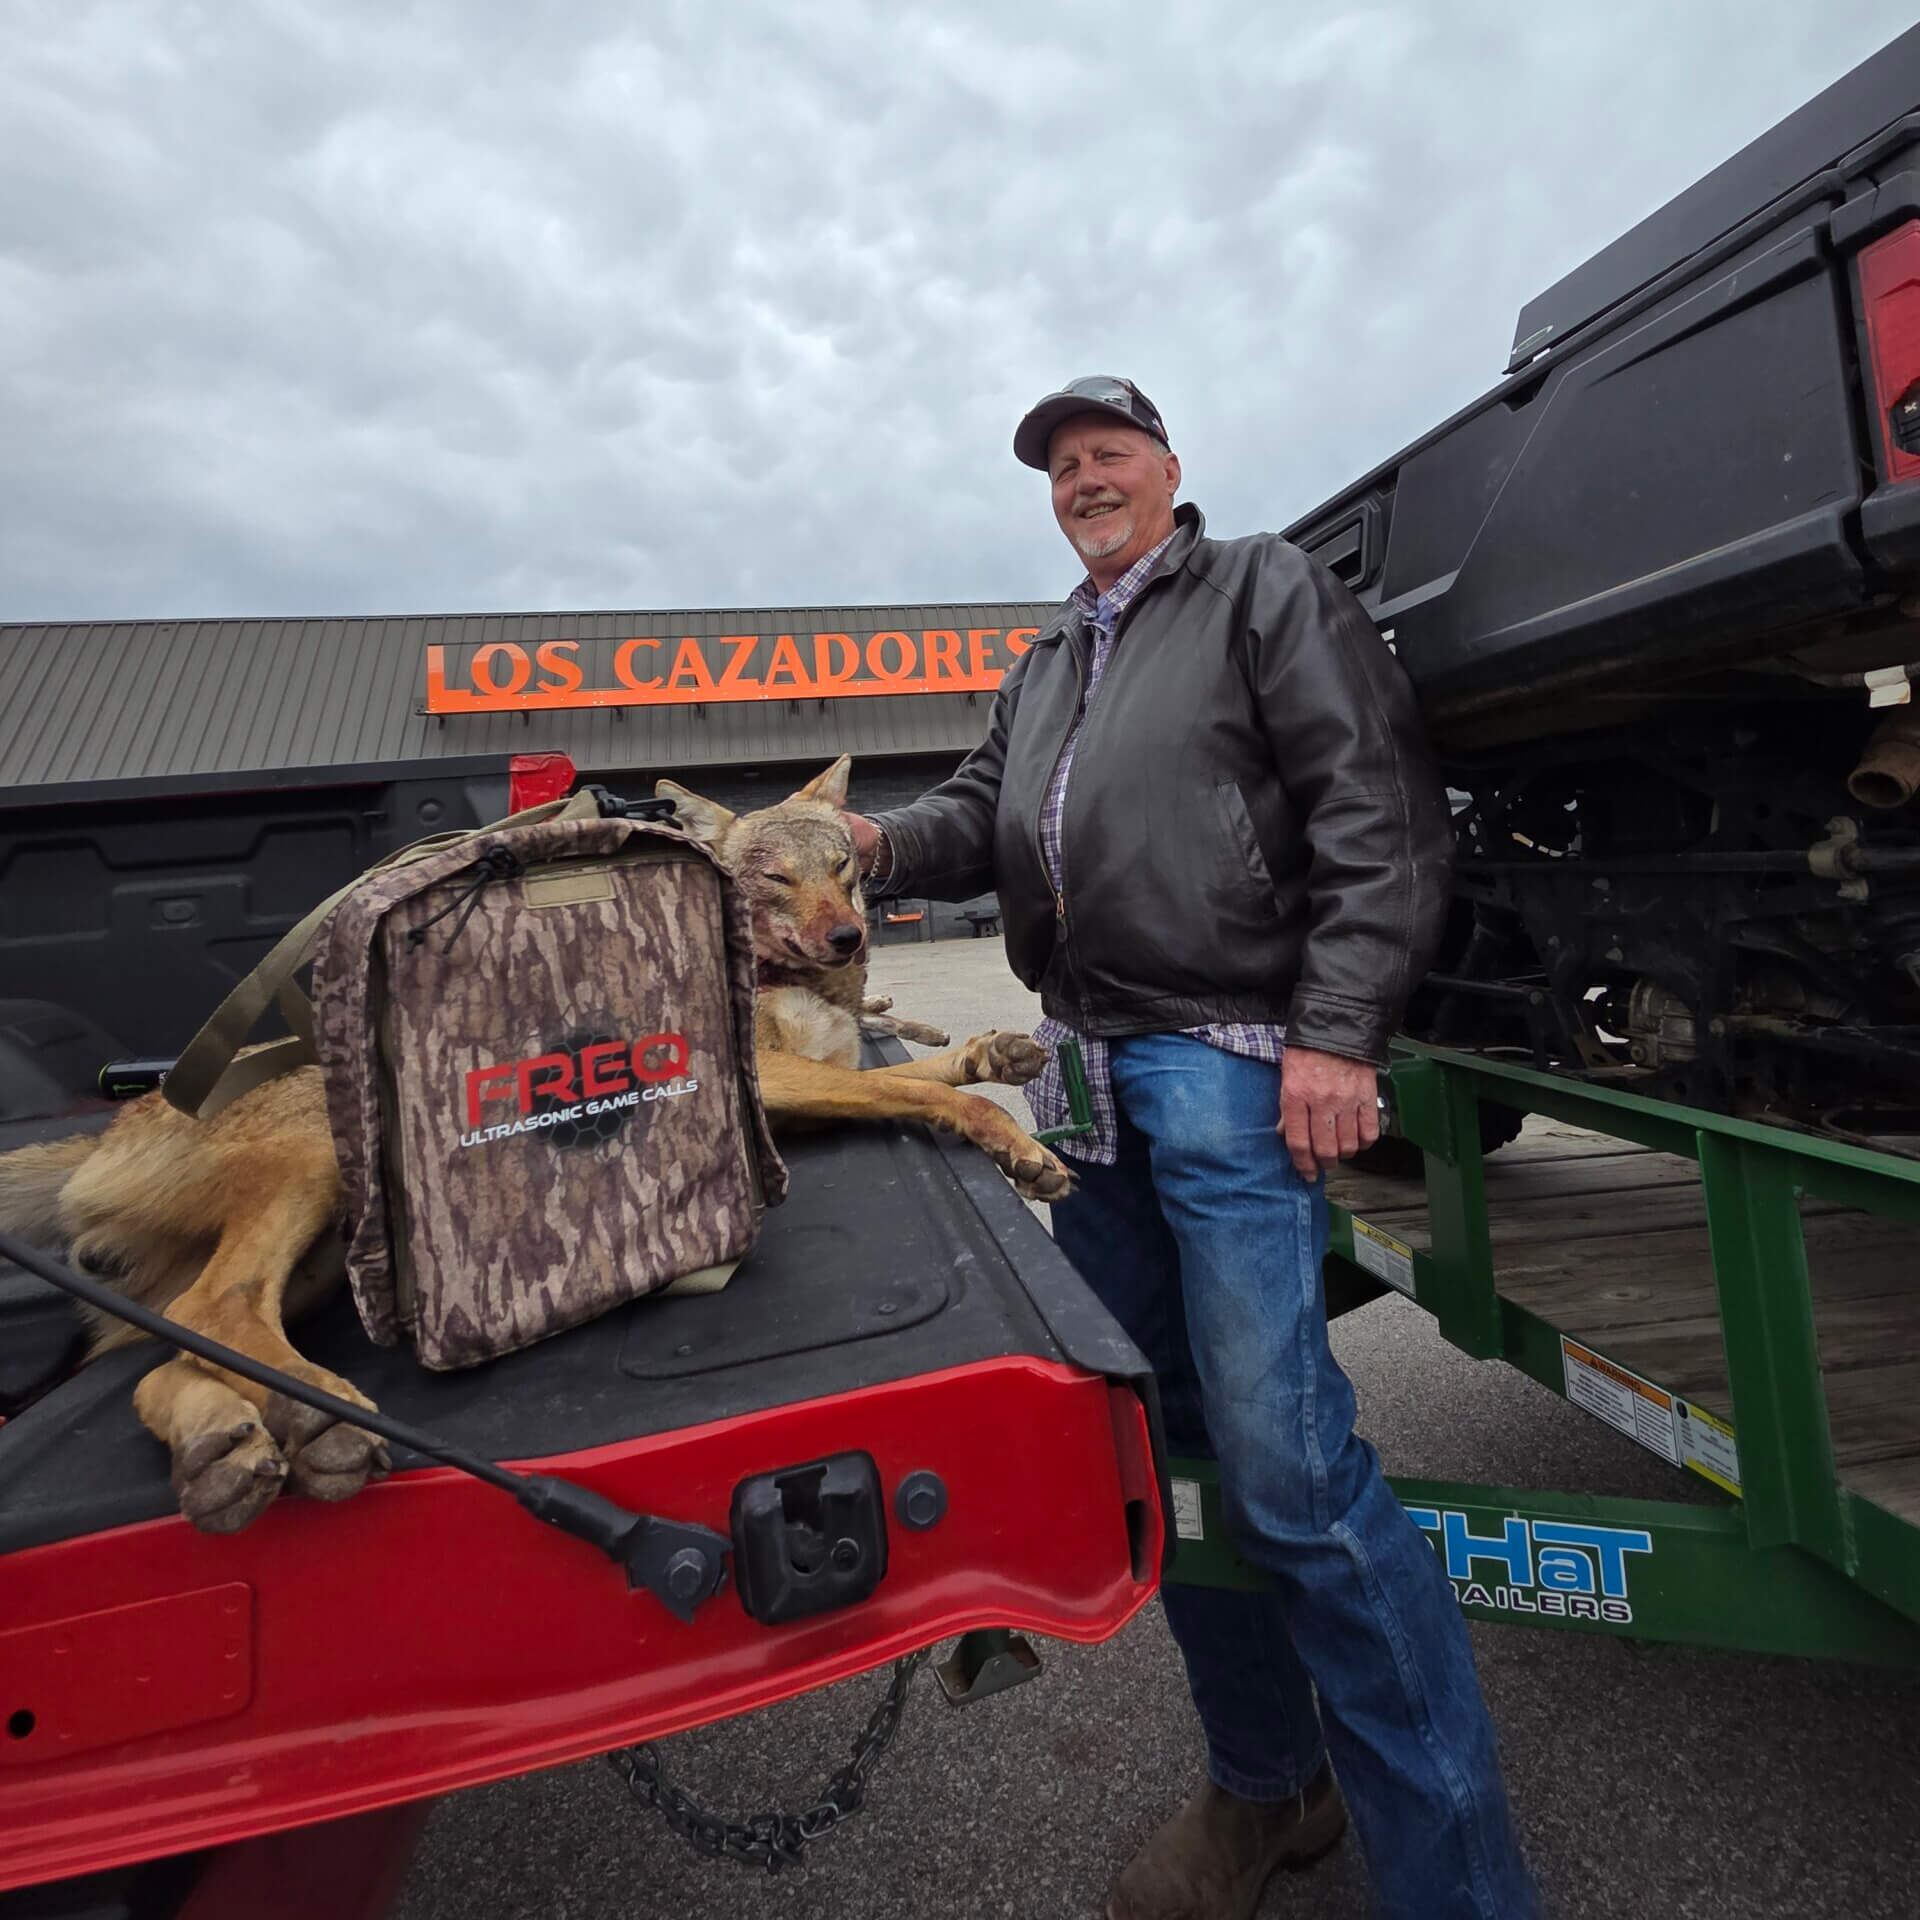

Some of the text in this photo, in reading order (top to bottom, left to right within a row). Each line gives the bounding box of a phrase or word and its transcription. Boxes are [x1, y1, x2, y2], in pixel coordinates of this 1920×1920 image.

[427, 628, 1041, 698] LOS CAZADORES
[460, 1079, 698, 1148] ULTRASONIC GAME CALLS
[465, 1033, 690, 1127] FREQ
[1402, 1506, 1653, 1598] HaT
[1450, 1581, 1633, 1624] AILERS
